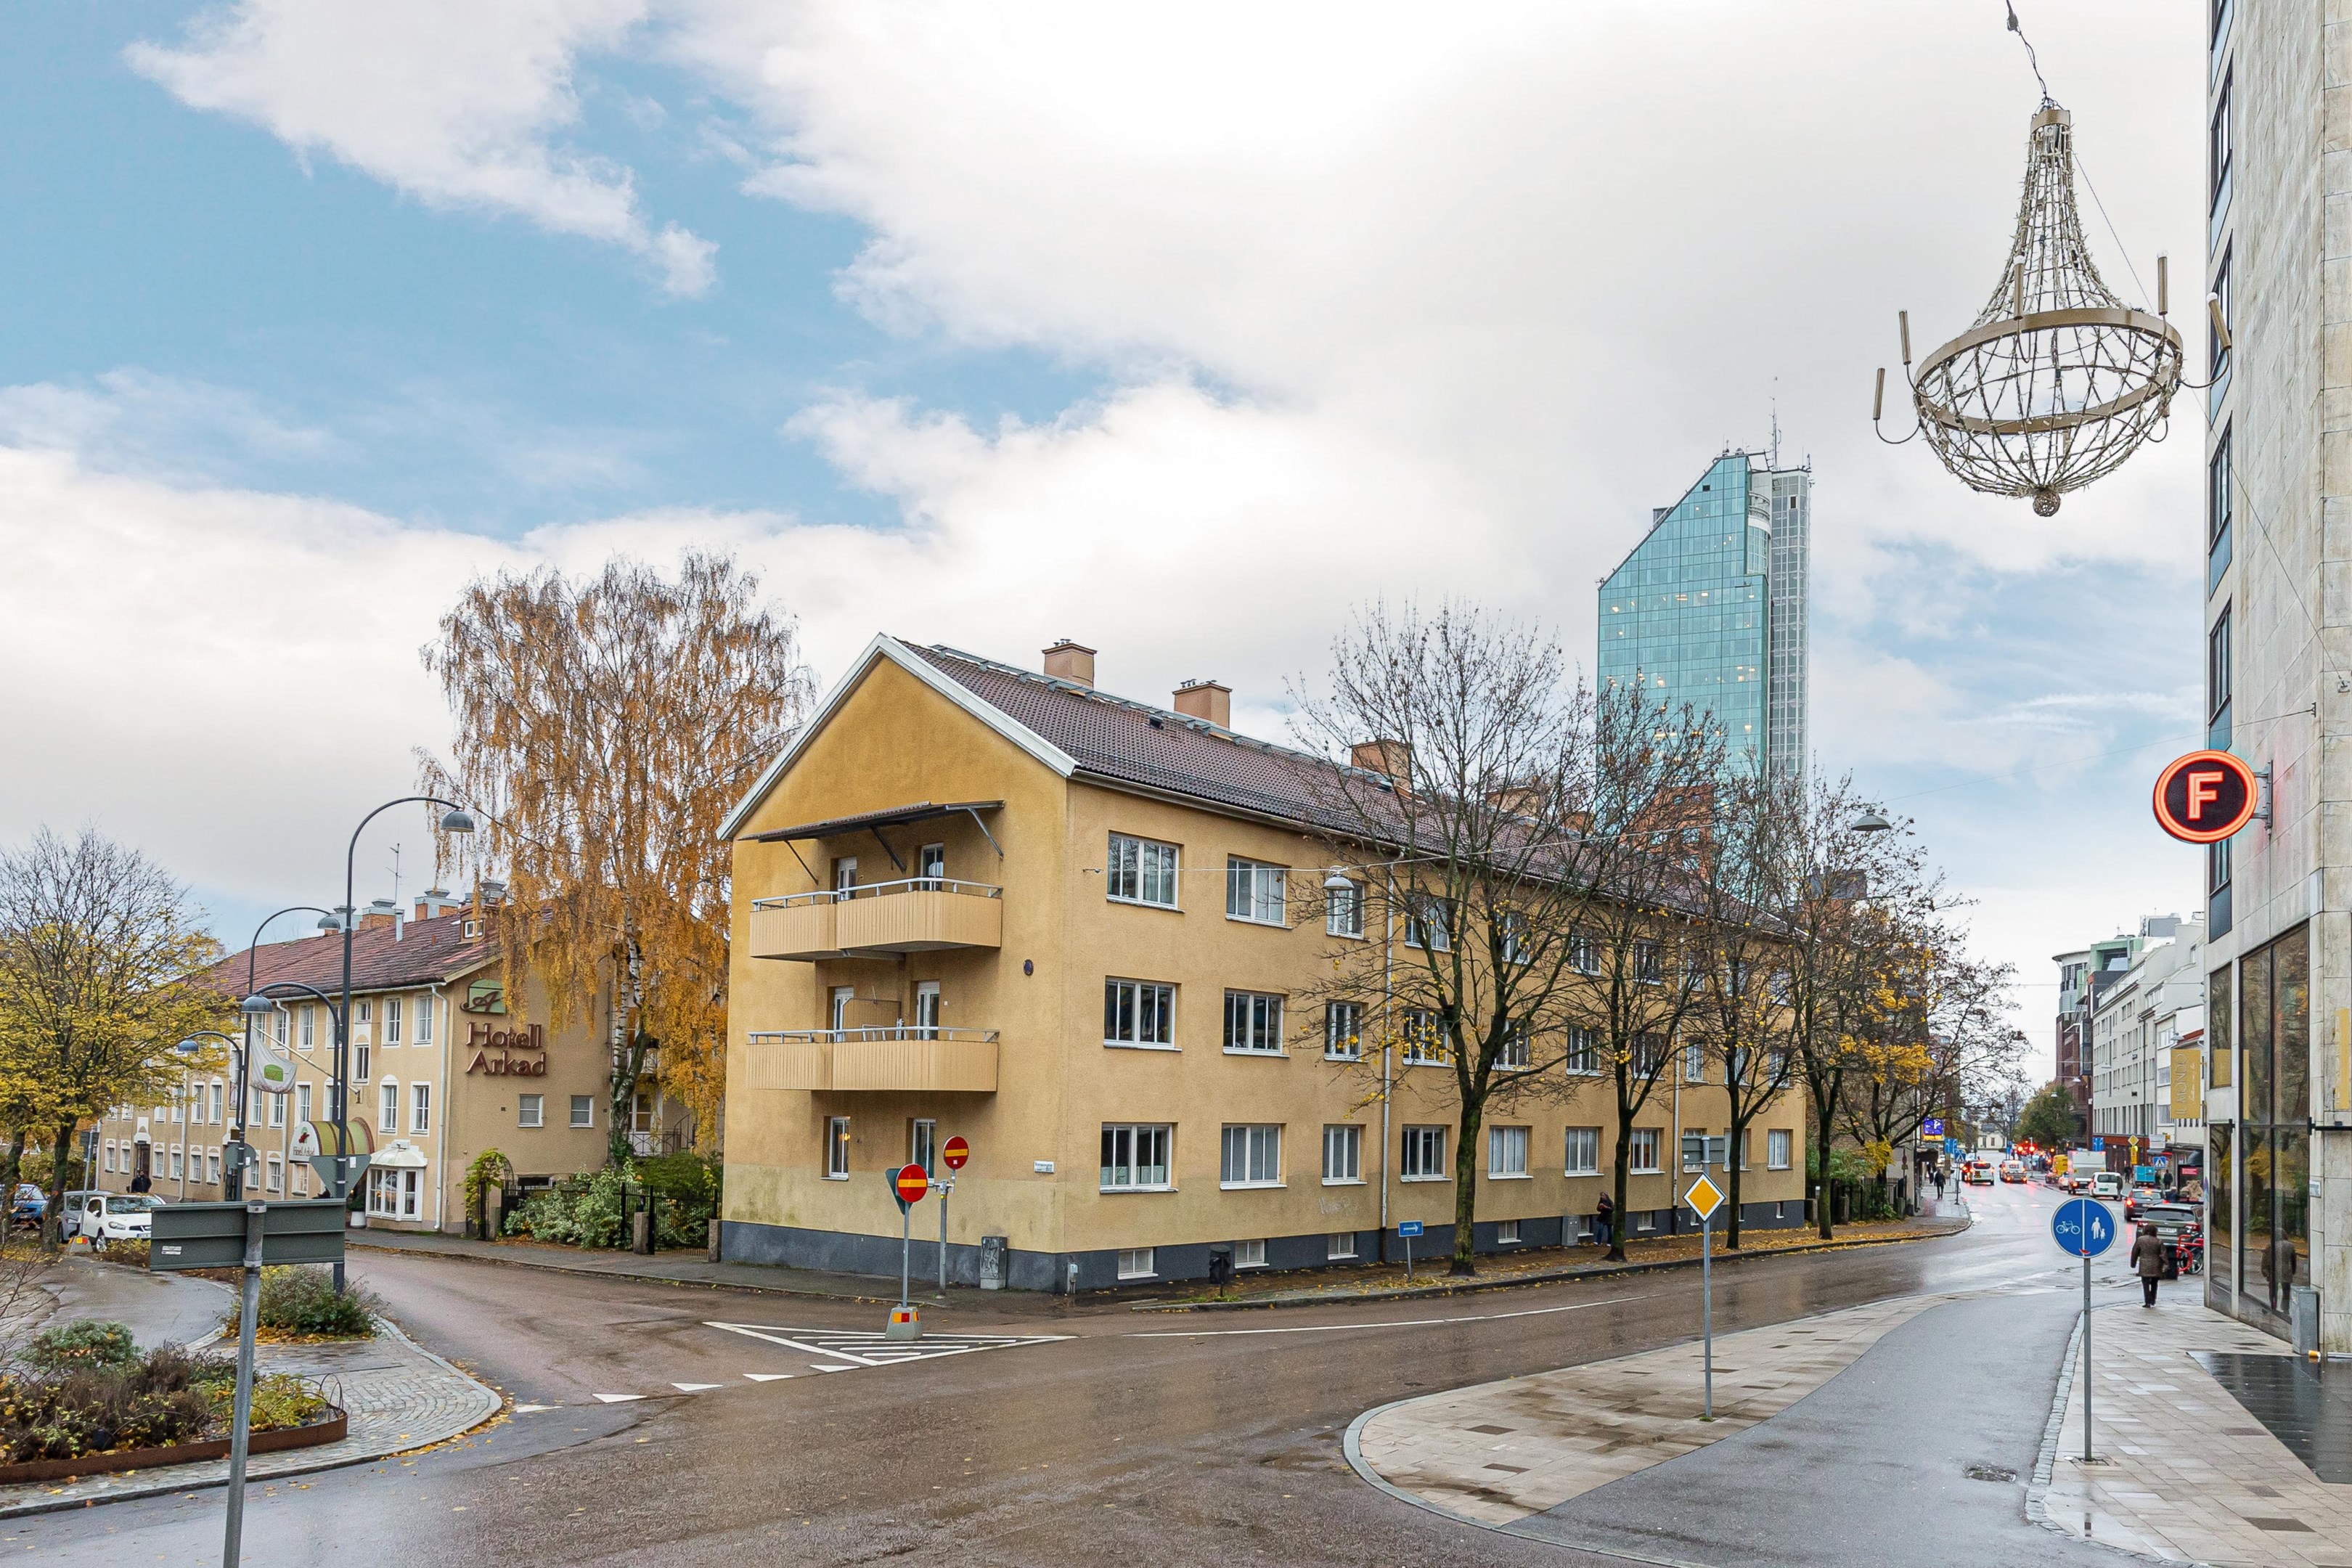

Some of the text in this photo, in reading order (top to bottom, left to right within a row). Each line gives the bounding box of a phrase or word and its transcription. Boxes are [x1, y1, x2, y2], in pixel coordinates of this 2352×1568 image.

[2187, 771, 2224, 821] F
[465, 1021, 542, 1048] Hotell
[465, 1050, 547, 1076] Arkad
[2176, 1053, 2186, 1103] MONDO
